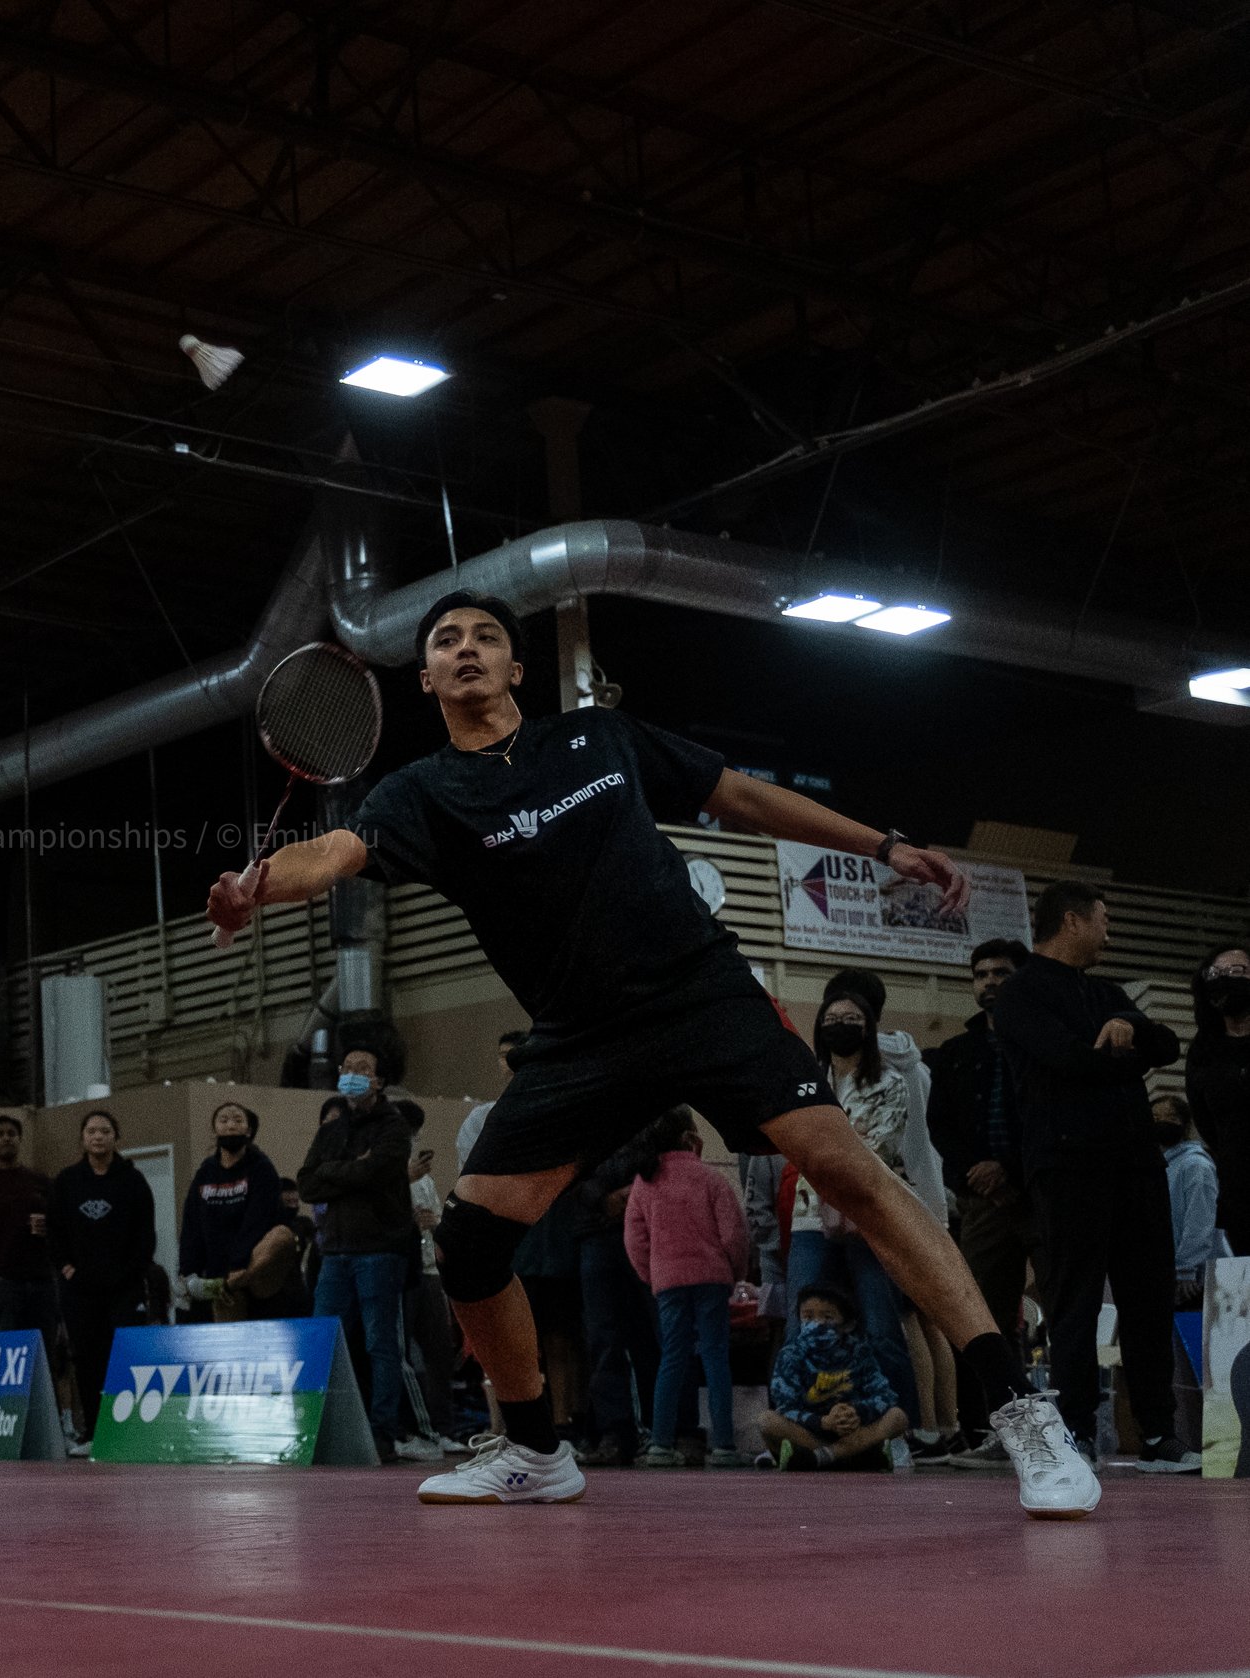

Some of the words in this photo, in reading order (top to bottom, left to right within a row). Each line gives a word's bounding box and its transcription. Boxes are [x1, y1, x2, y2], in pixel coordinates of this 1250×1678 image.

[538, 772, 626, 824] BADMINTON
[482, 827, 516, 848] BAY
[826, 855, 876, 883] USA
[828, 884, 878, 904] TOUCH-UP
[1, 1344, 28, 1386] Xi
[186, 1360, 305, 1422] YONEX
